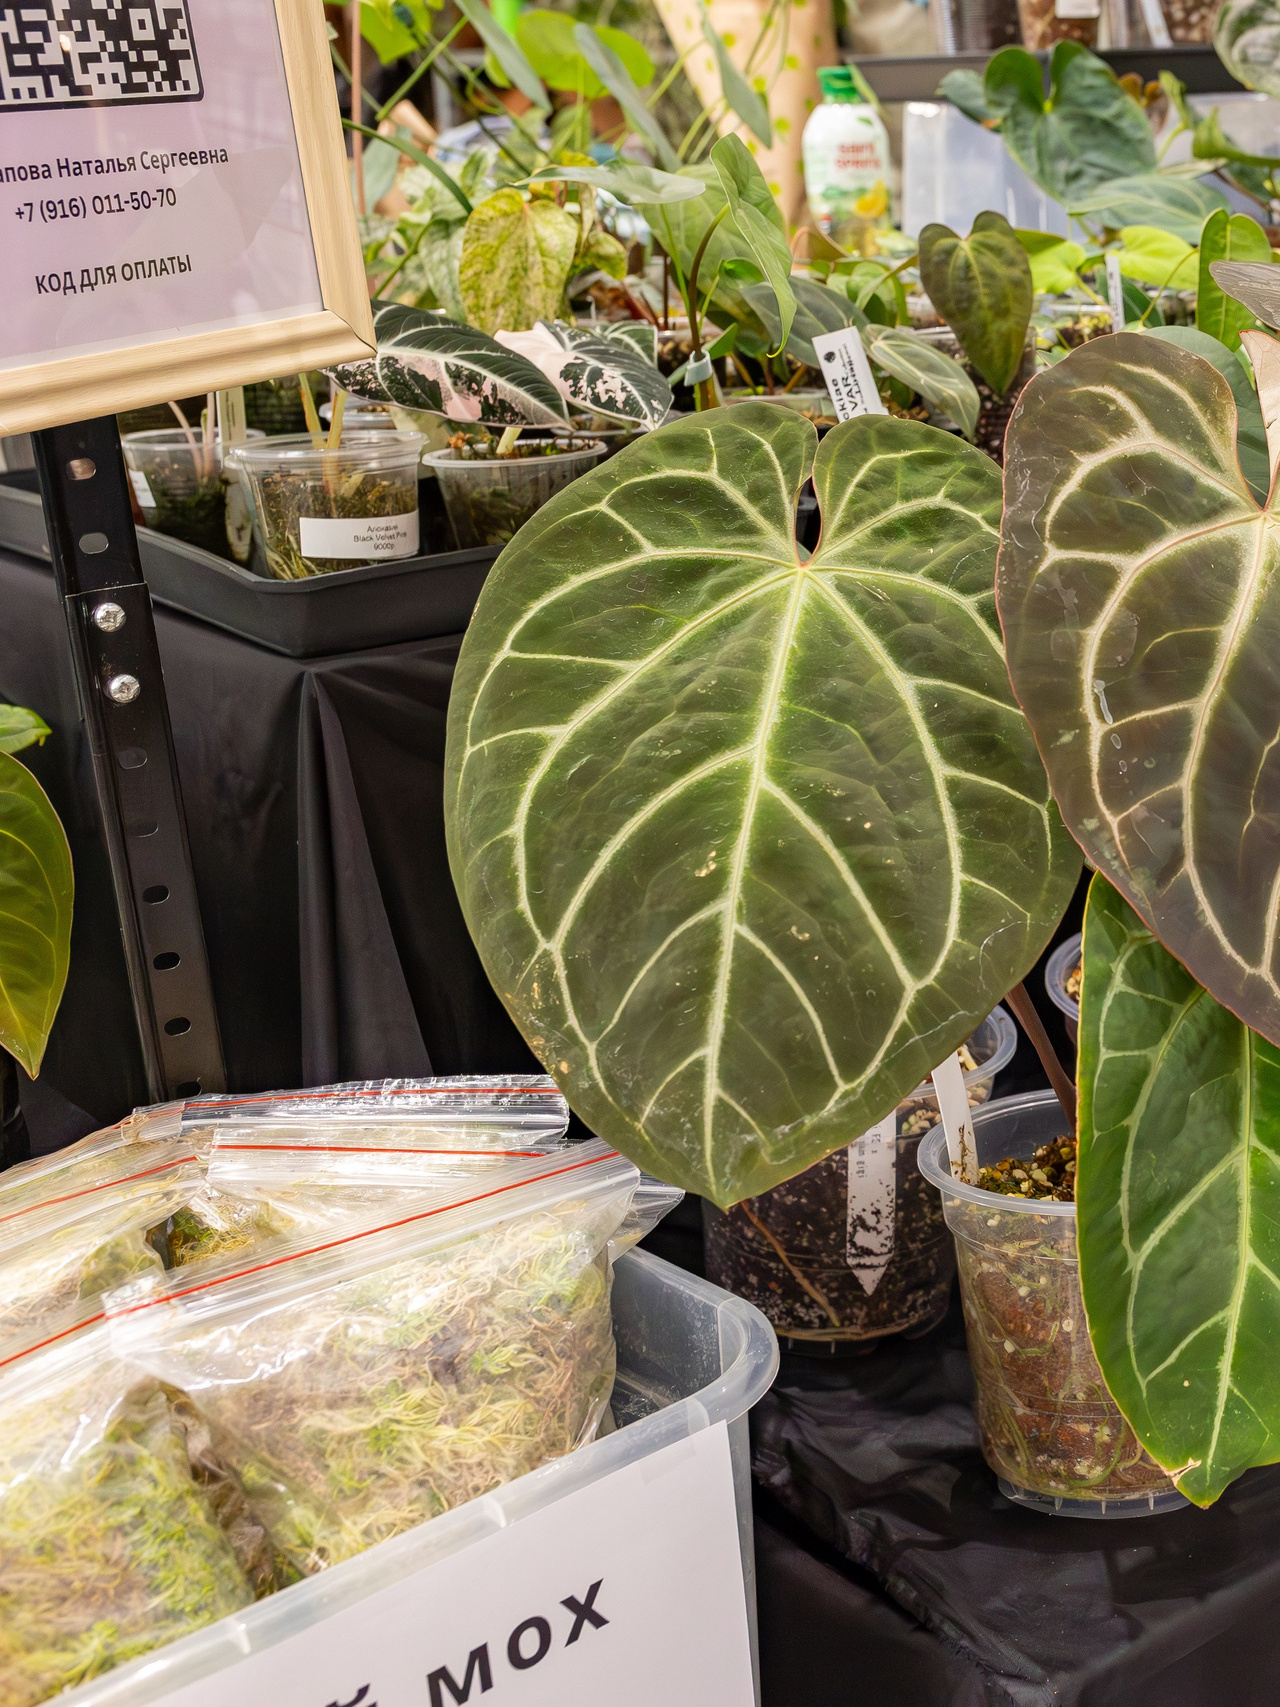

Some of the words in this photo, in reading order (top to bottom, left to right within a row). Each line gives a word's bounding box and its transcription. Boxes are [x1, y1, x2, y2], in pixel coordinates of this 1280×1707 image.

[56, 155, 137, 178] Наталья
[140, 148, 229, 174] Сергеевна
[15, 202, 34, 222] +7
[40, 195, 87, 223] (916)
[92, 187, 177, 215] 011-50-70
[353, 534, 374, 543] Black
